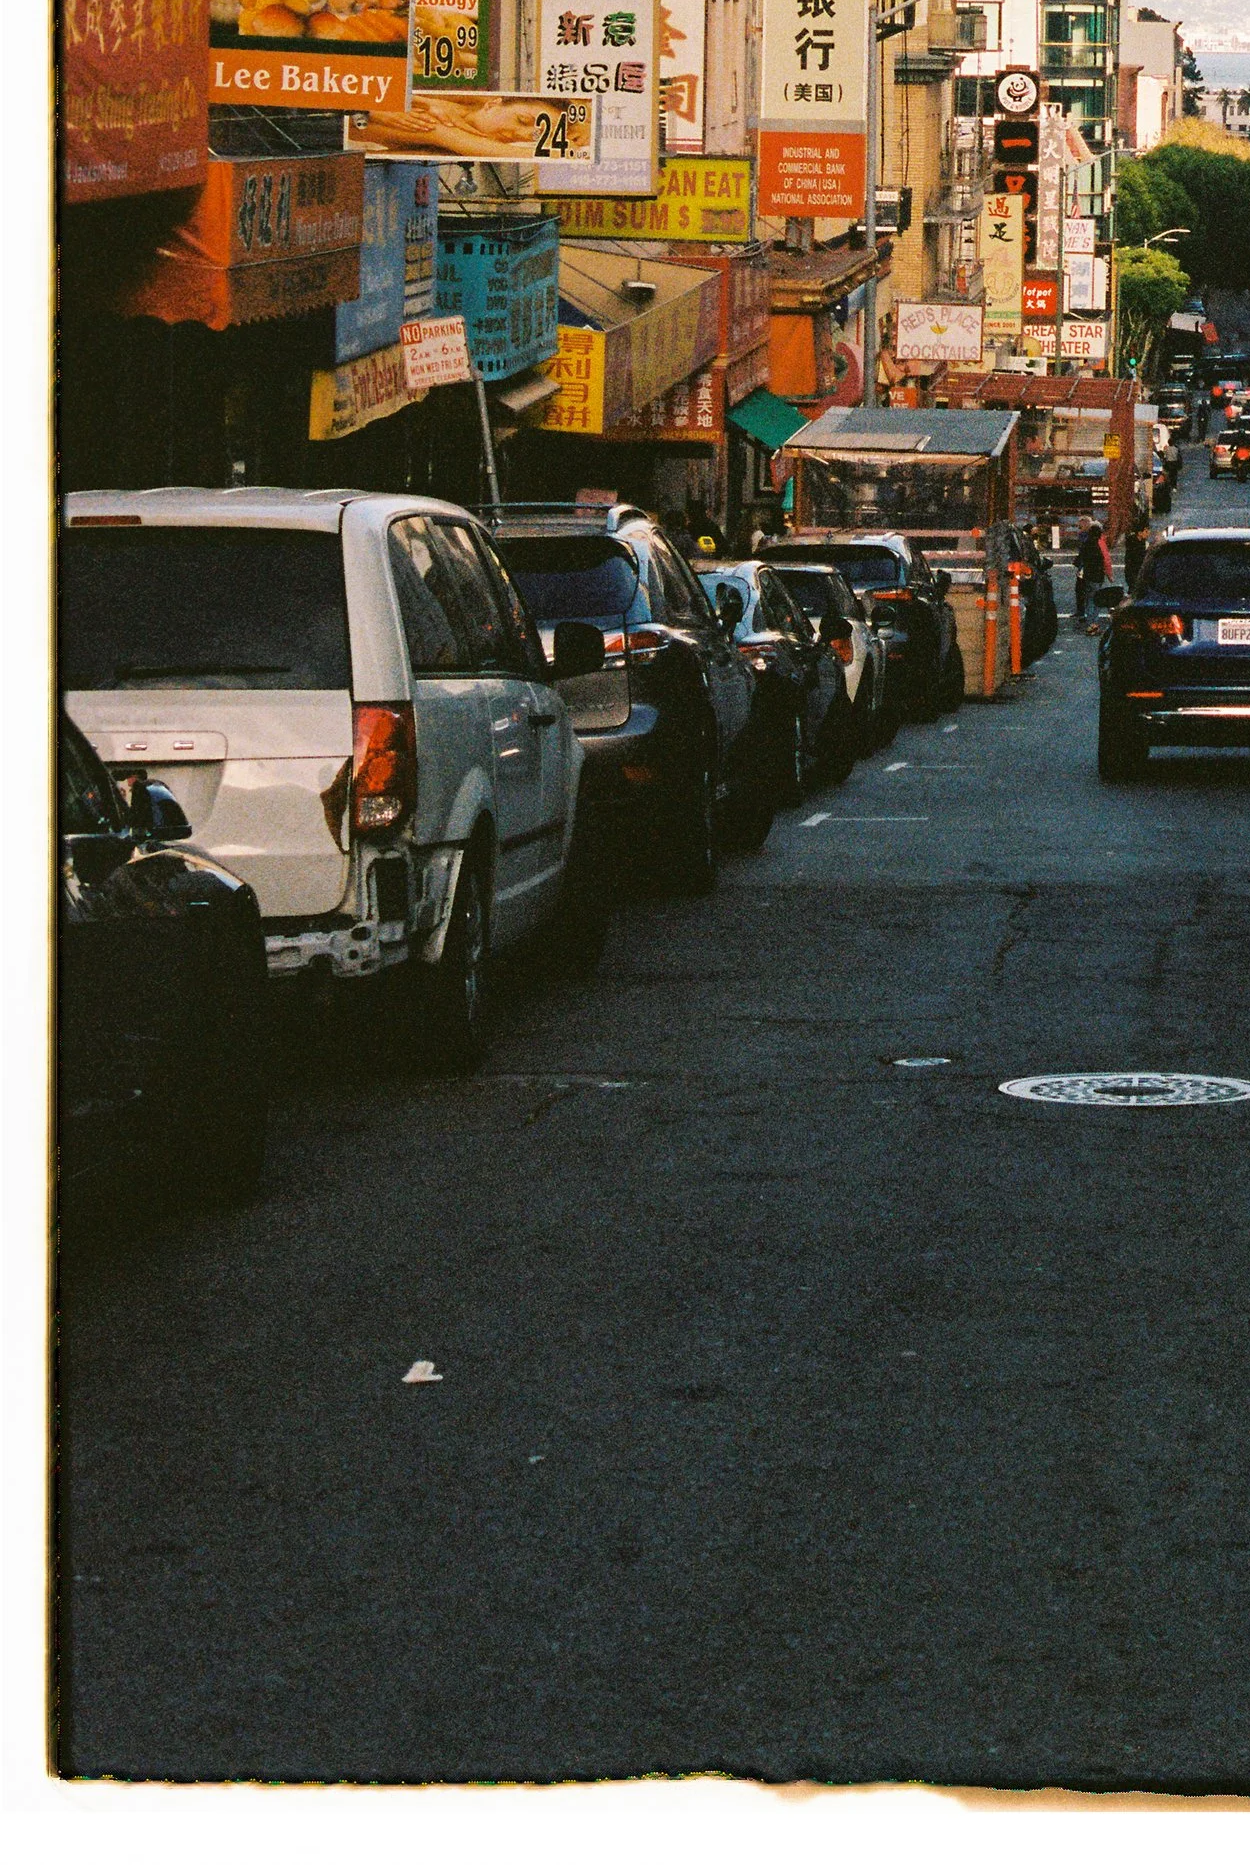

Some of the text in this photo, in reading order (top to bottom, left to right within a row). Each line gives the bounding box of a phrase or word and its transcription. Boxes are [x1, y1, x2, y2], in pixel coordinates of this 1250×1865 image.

[464, 68, 478, 79] UP
[215, 61, 393, 104] Lee Bakery
[575, 150, 588, 159] UP
[782, 146, 840, 160] INDUSTRIAL AND
[778, 162, 846, 175] COMMERCIAL BANK
[657, 169, 697, 197] CAN
[704, 171, 745, 199] EAT
[783, 177, 794, 189] OF
[796, 178, 817, 190] CHINA
[771, 193, 853, 206] NATIONAL ASSOCIATION
[557, 201, 604, 228] DIM
[613, 201, 669, 231] SUM
[678, 204, 690, 230] $
[1065, 222, 1088, 233] NAN
[940, 306, 980, 335] PLACE
[403, 322, 463, 344] NO PARKING
[1023, 324, 1104, 339] GREA STAR
[410, 347, 418, 361] 2
[441, 342, 449, 356] 6
[900, 343, 978, 360] COCKTAILS
[410, 364, 425, 375] MON
[426, 361, 440, 373] WED
[453, 356, 464, 369] SAT
